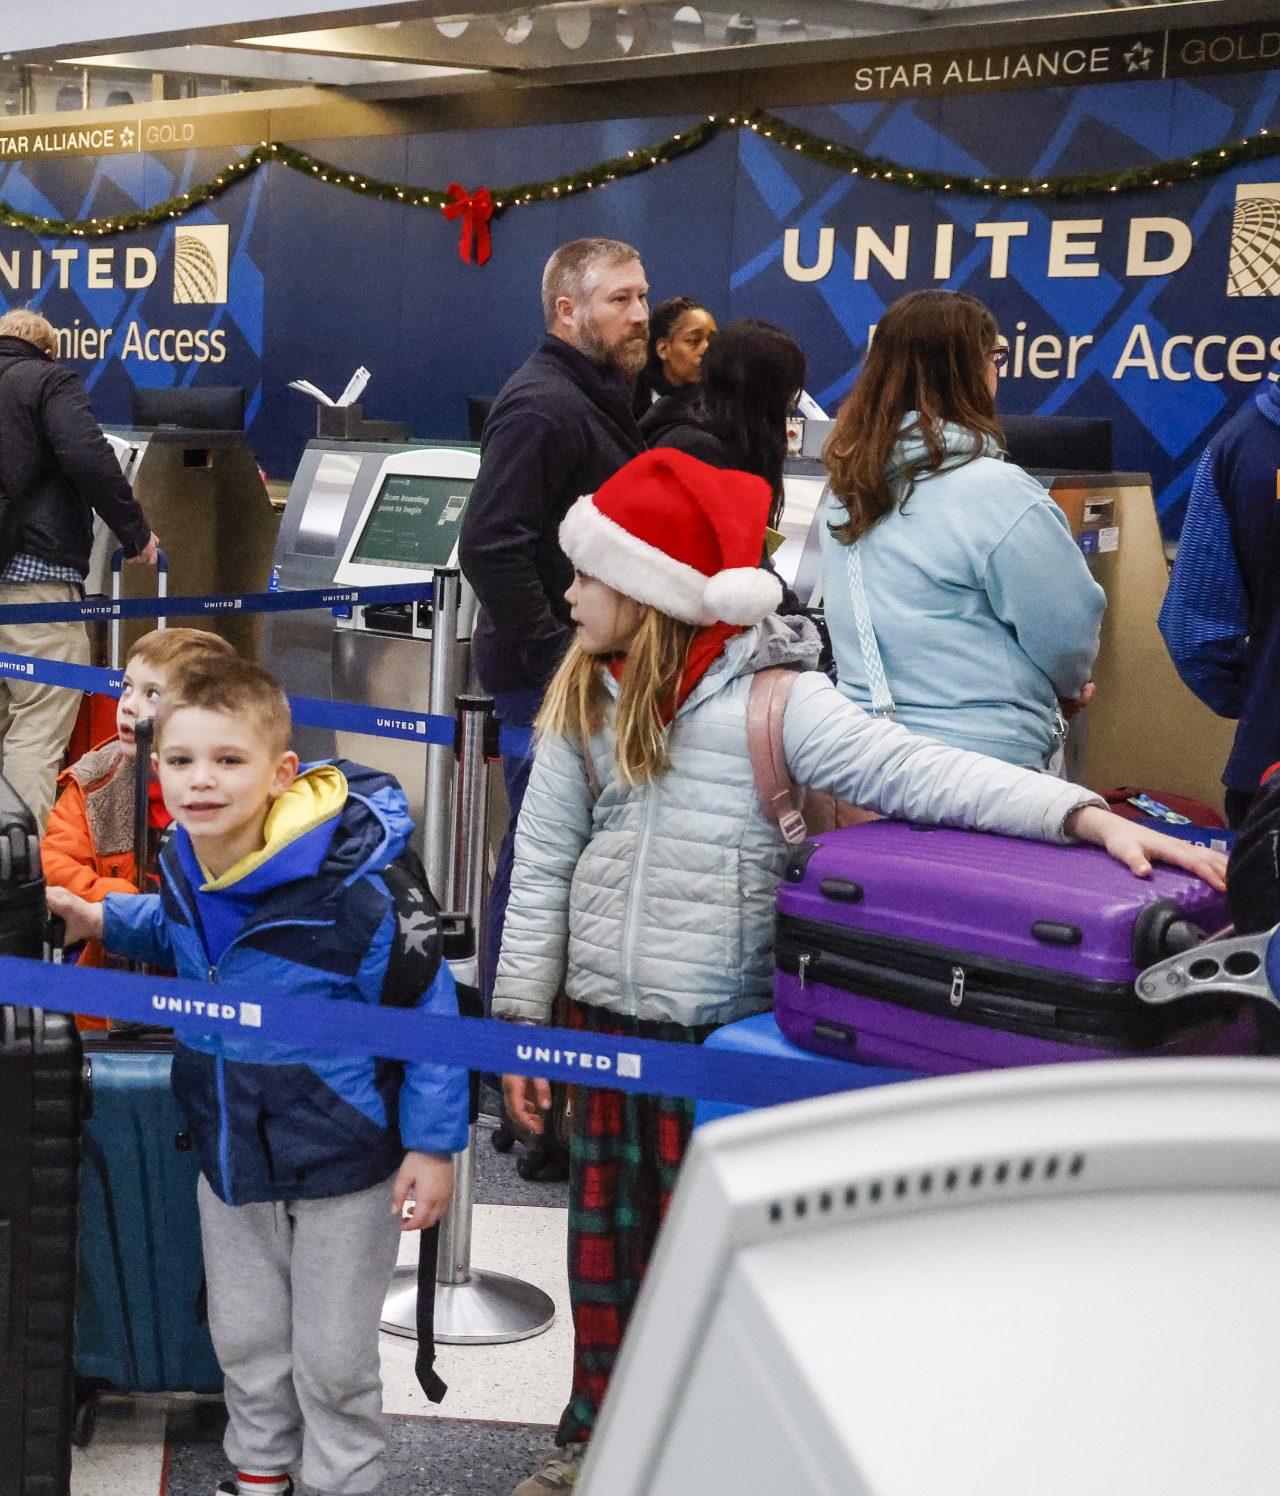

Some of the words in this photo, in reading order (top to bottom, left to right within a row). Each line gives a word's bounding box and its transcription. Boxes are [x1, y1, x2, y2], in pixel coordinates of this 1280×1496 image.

[854, 64, 932, 92] STAR
[943, 48, 1110, 84] ALLIANCE
[1181, 32, 1280, 64] GOLD
[33, 129, 114, 152] ALLIANCE
[146, 123, 194, 145] GOLD
[783, 216, 1193, 282] UNITED
[54, 319, 112, 360] mier
[121, 321, 227, 362] Access
[1112, 323, 1280, 382] Acce
[383, 492, 400, 501] Scan
[401, 494, 430, 505] boarding
[403, 506, 422, 515] begin
[204, 601, 234, 609] UNITED
[322, 594, 350, 602] UNITED
[376, 718, 415, 730] UNITED
[152, 995, 236, 1020] UNITED
[516, 1045, 612, 1070] UNITED
